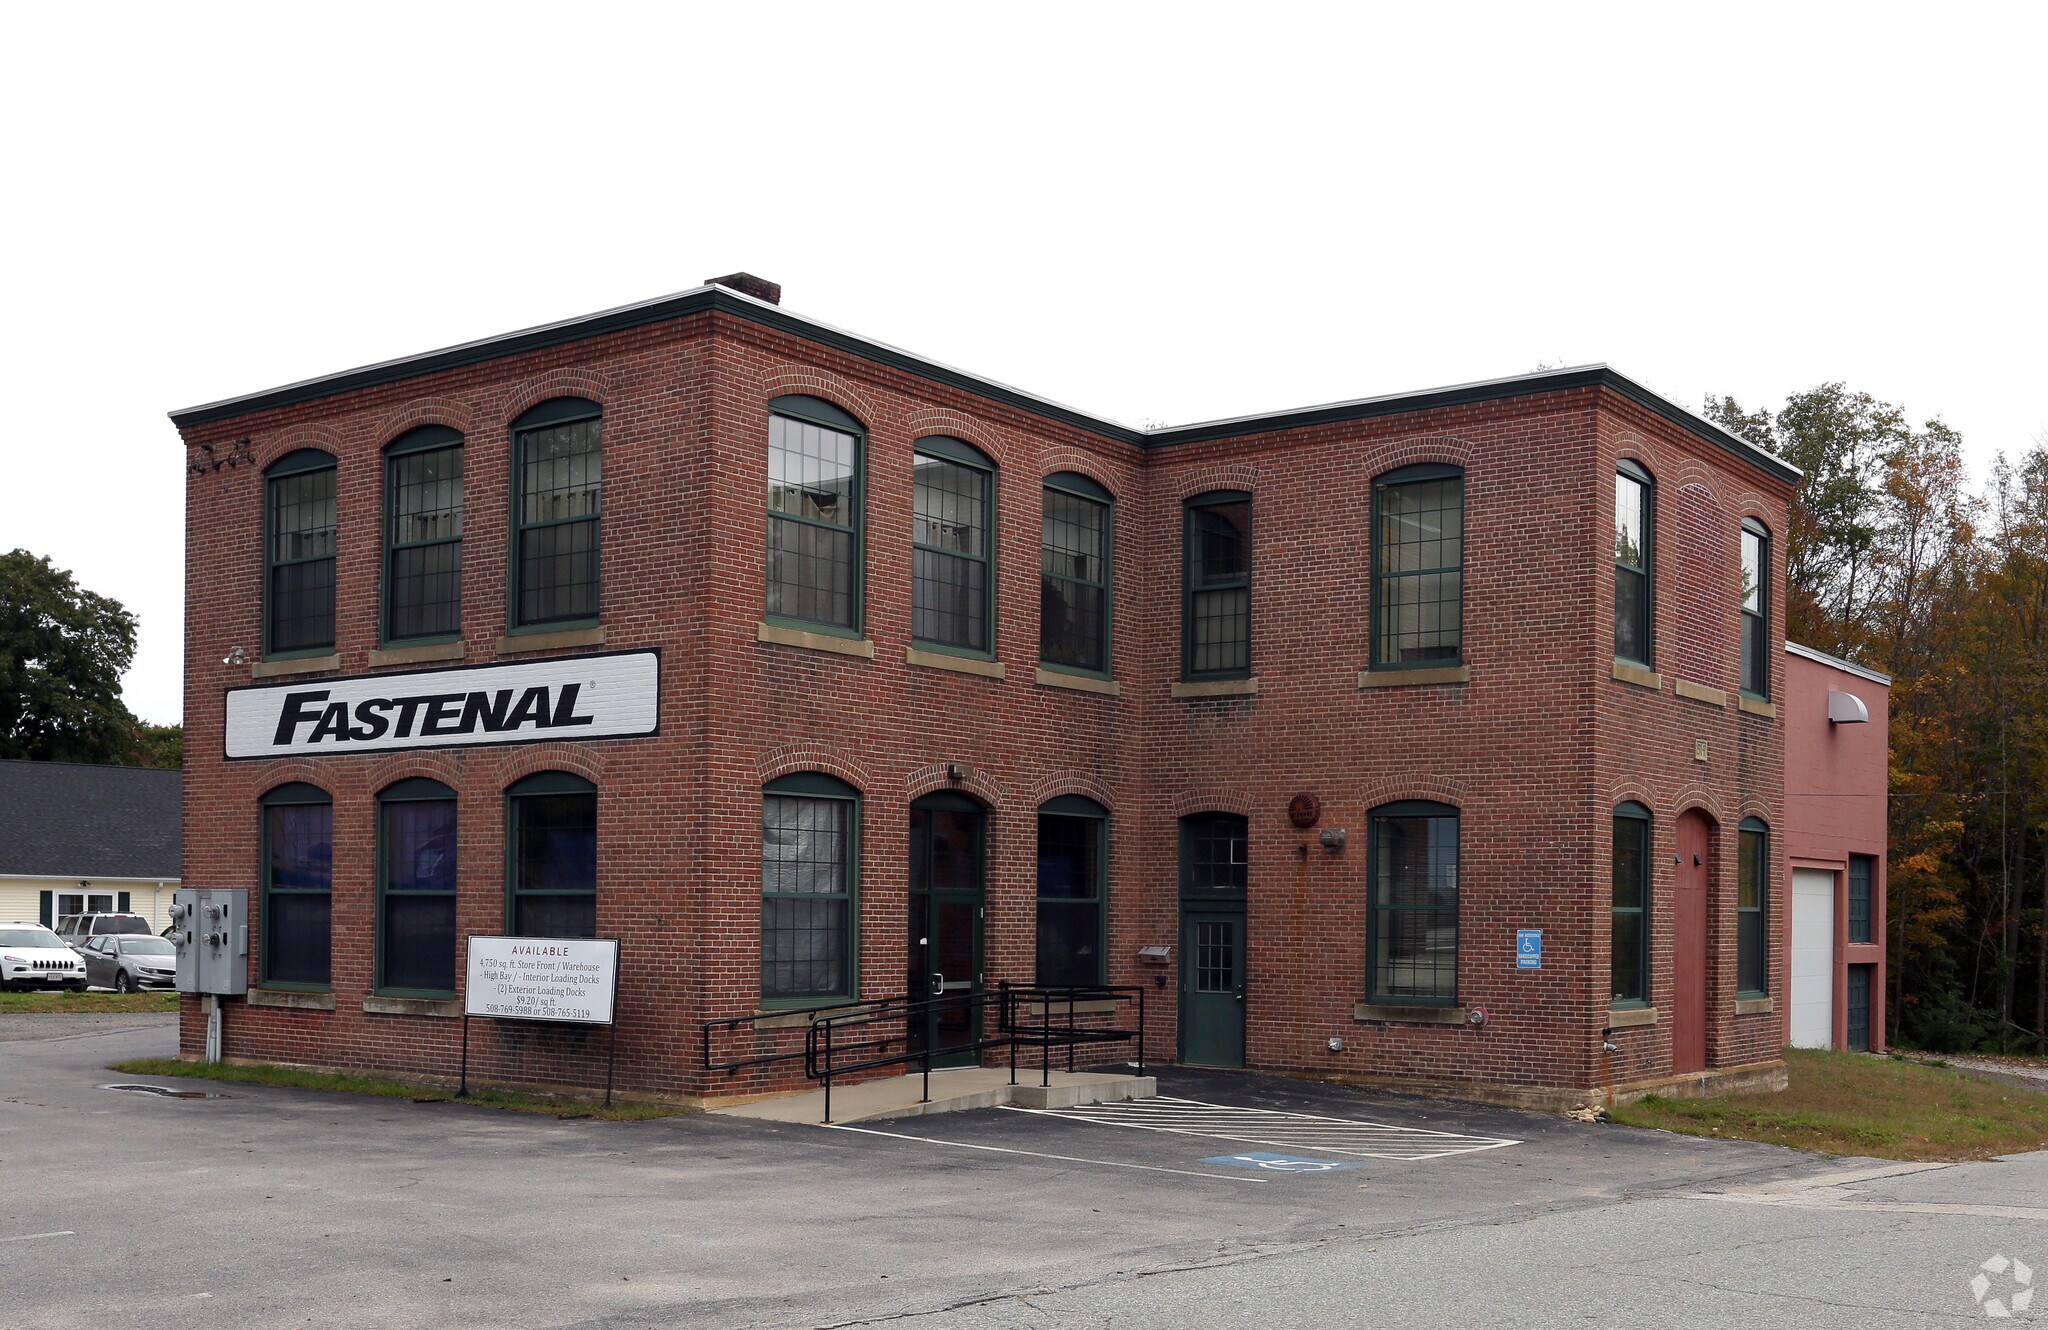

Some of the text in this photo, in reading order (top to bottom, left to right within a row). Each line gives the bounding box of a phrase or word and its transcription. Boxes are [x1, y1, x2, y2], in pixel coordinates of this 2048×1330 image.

[272, 683, 594, 746] FASTENAL
[511, 945, 569, 957] AVAILABLE
[479, 958, 498, 968] 4,750
[509, 959, 517, 969] ft.
[517, 960, 535, 970] Store
[536, 960, 555, 970] Front
[556, 961, 561, 972] /
[562, 961, 600, 972] Warehouse
[484, 970, 499, 982] High
[499, 971, 512, 982] Bay
[512, 971, 518, 982] /
[523, 972, 550, 982] Interior
[551, 973, 578, 985] Loading
[579, 974, 600, 984] Docks
[497, 983, 507, 995] (2)
[508, 984, 537, 994] Exterior
[537, 986, 565, 998] Loading
[566, 987, 586, 997] Docks
